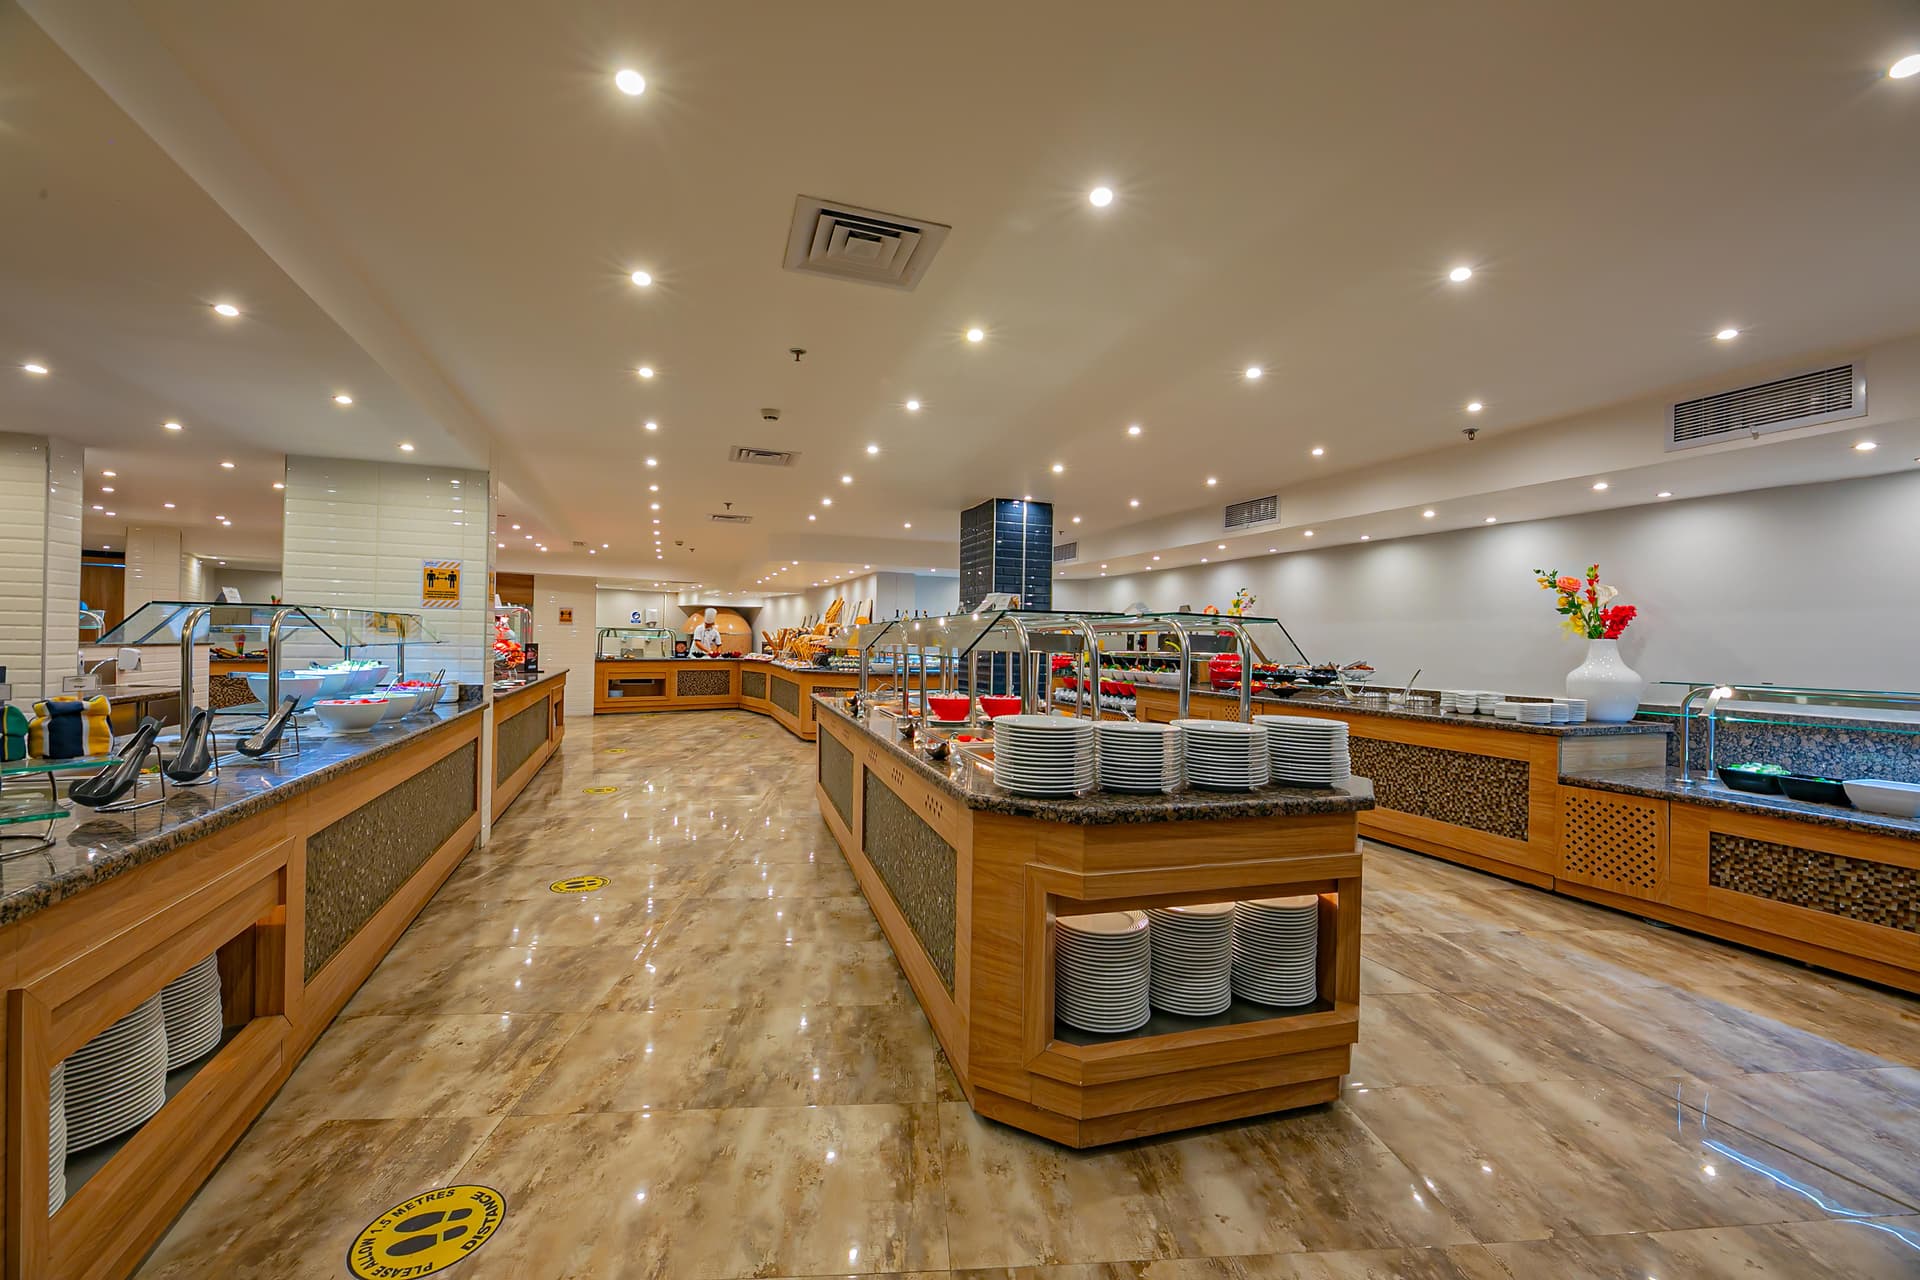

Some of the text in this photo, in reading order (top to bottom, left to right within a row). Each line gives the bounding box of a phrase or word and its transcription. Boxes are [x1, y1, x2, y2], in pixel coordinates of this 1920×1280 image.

[358, 1189, 499, 1279] PLEASE ALLOW 1.5 METRES DISTANCE
